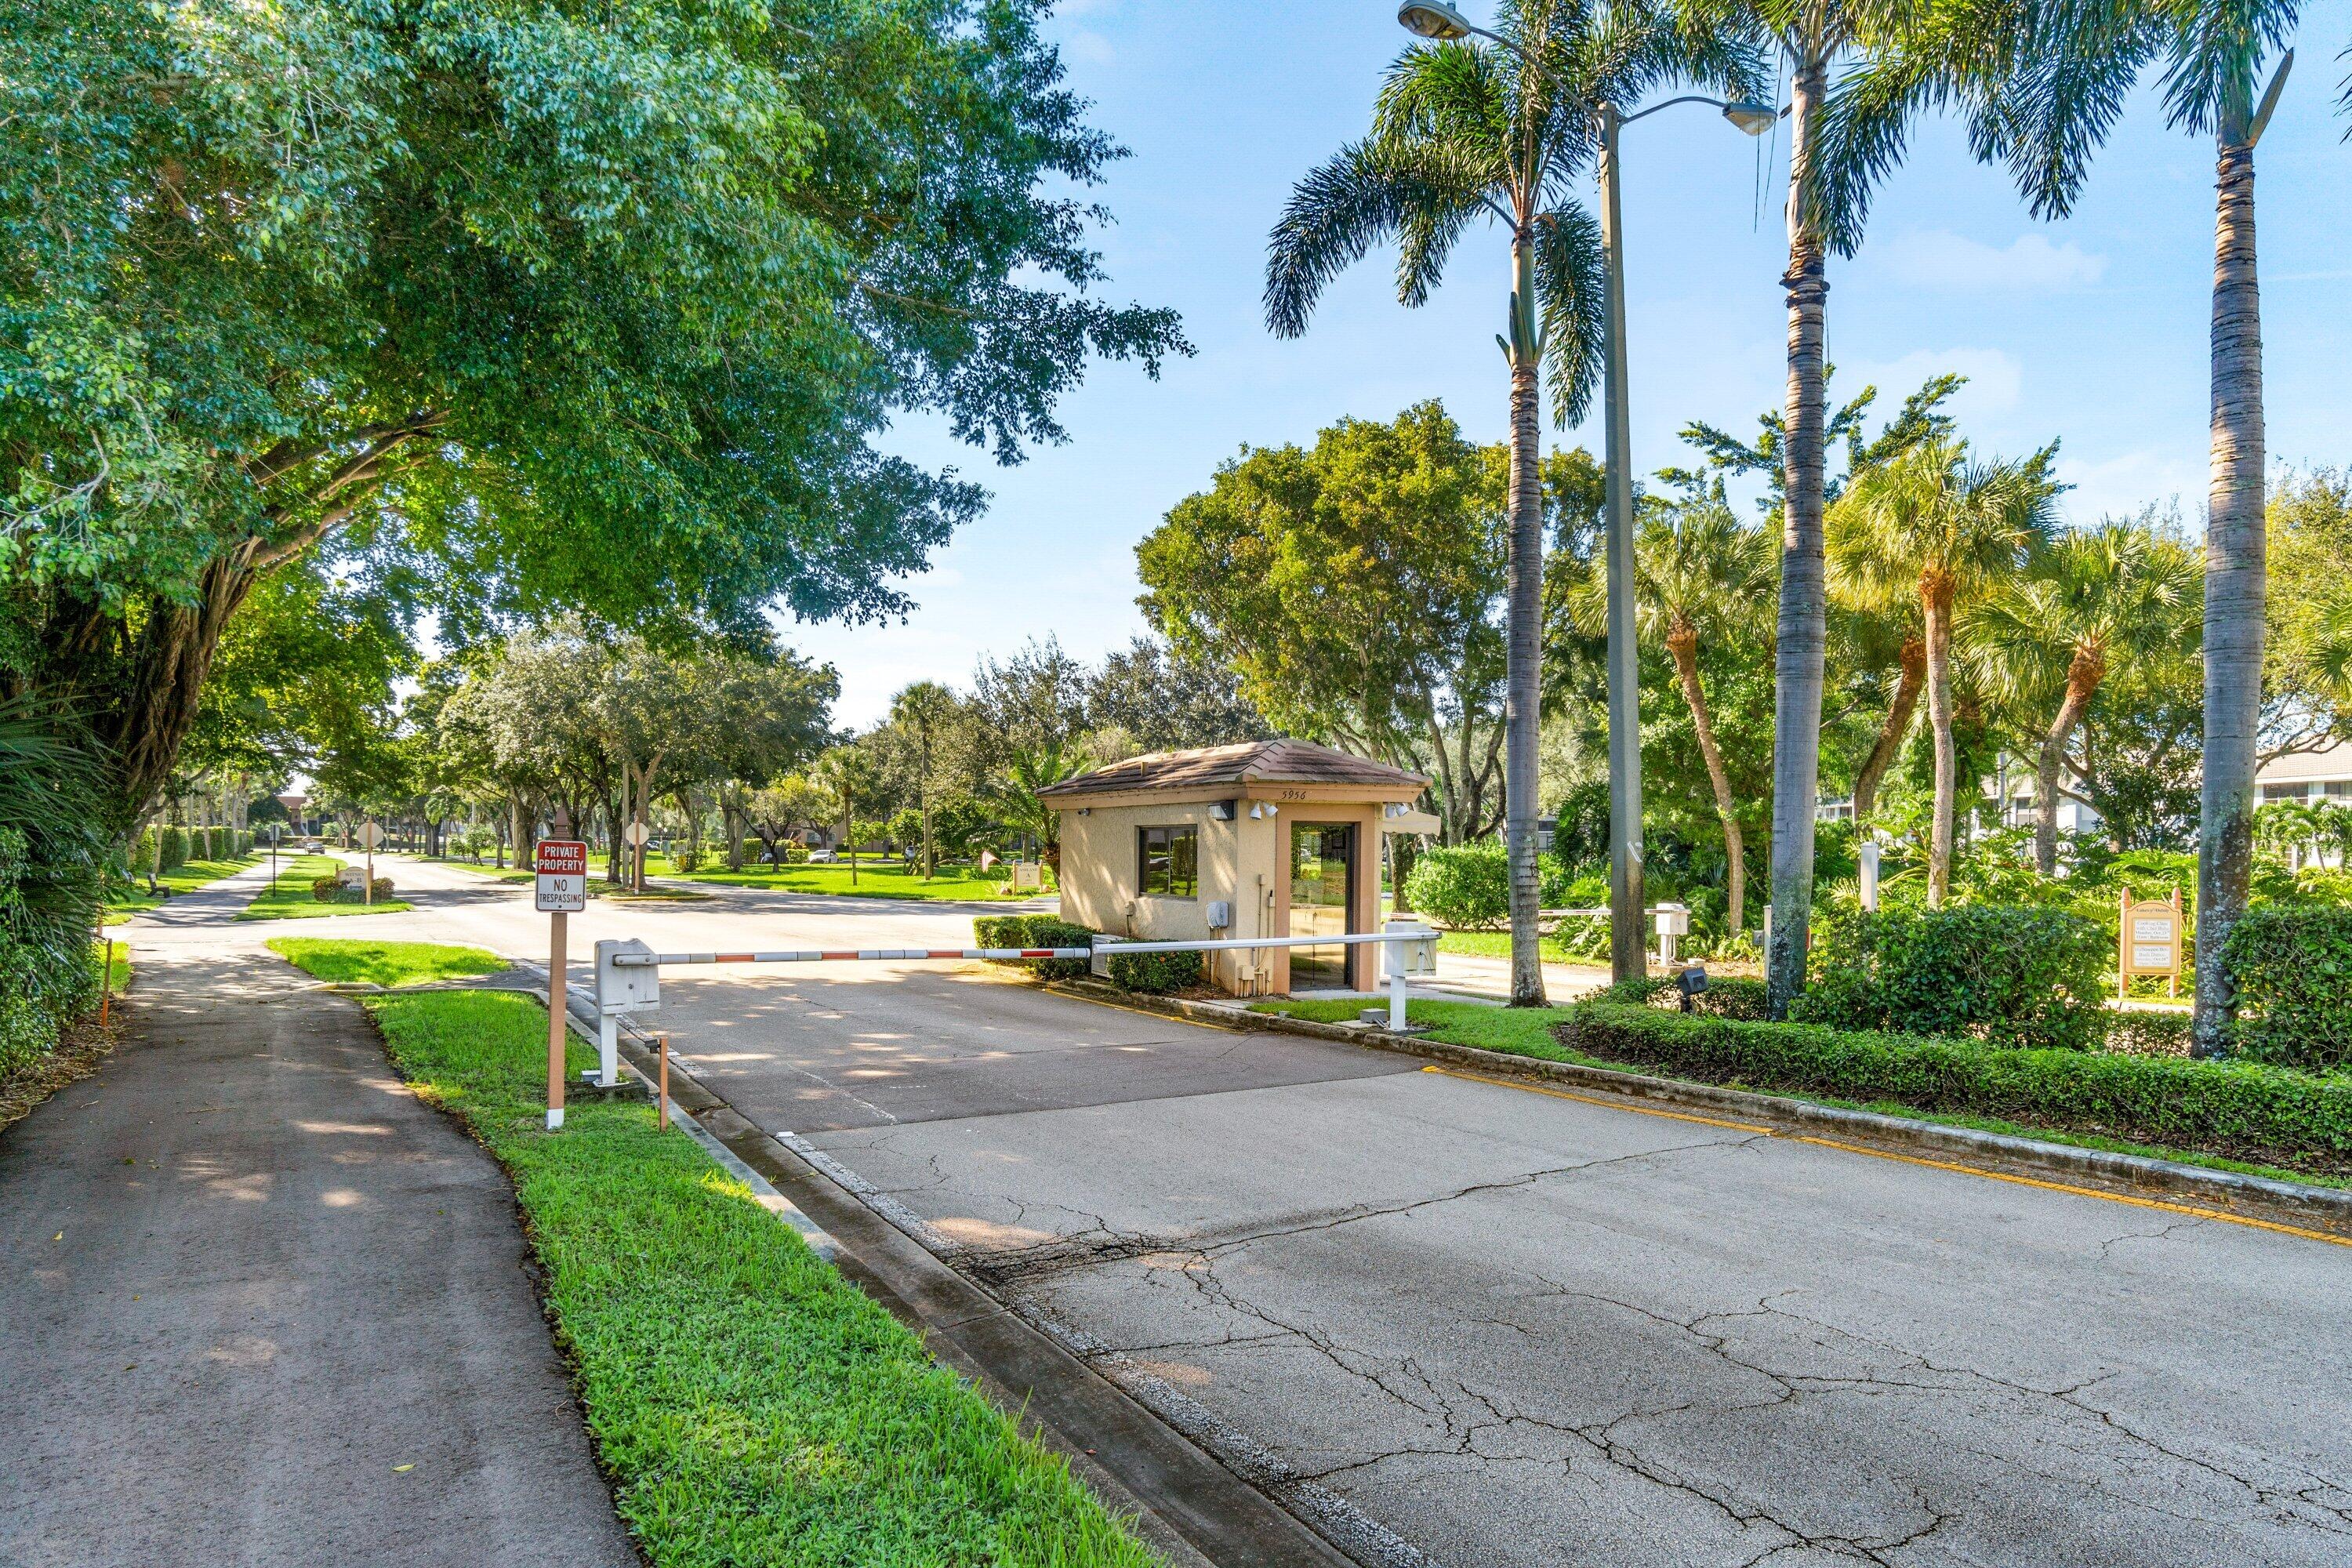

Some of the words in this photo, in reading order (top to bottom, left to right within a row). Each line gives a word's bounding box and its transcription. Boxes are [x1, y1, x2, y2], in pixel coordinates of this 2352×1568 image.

[1281, 789, 1306, 800] 5956
[544, 846, 579, 858] PRIVATE
[539, 859, 584, 871] PROPERTY
[554, 879, 568, 891] NO
[539, 894, 582, 902] TRESPASSING
